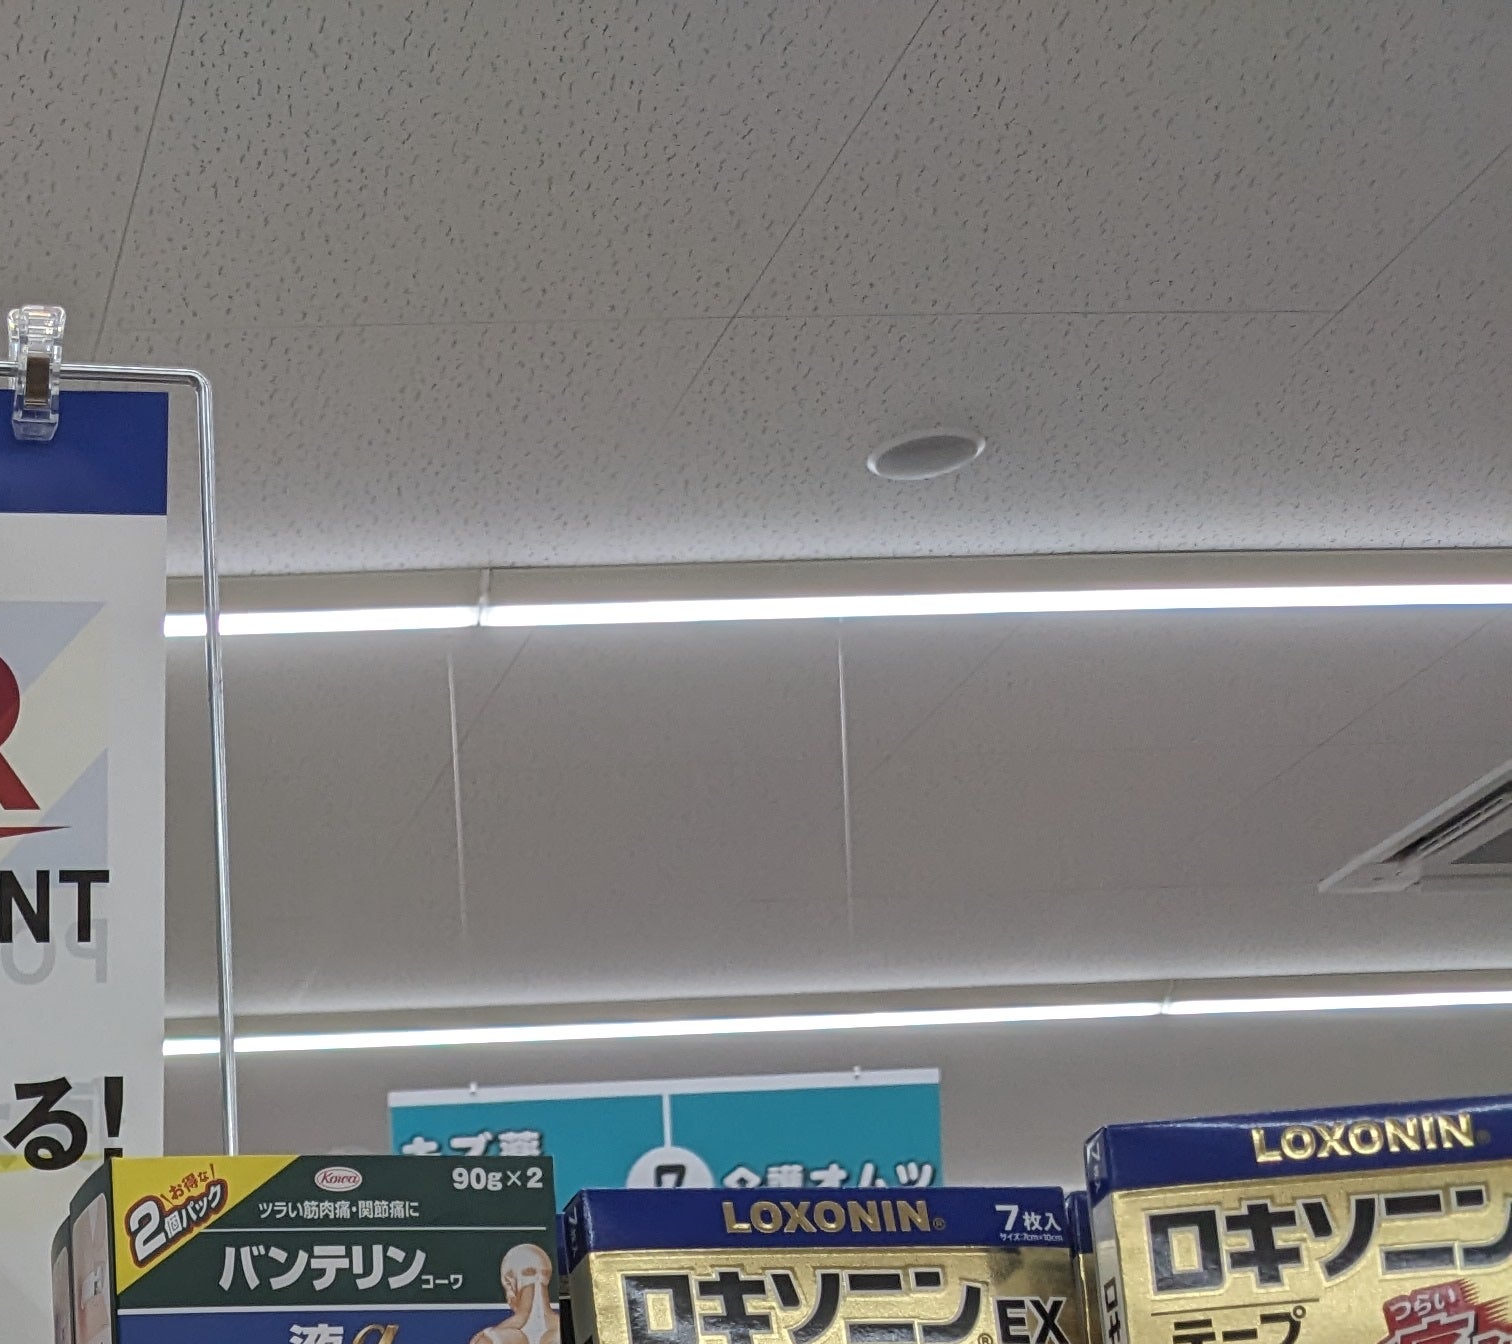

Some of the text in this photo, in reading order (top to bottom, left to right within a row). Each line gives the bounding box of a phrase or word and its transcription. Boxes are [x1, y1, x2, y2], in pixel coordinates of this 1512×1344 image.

[1252, 1114, 1474, 1164] LOXONIN
[723, 1201, 931, 1233] LOXONIN
[219, 1245, 425, 1293] バンテリン
